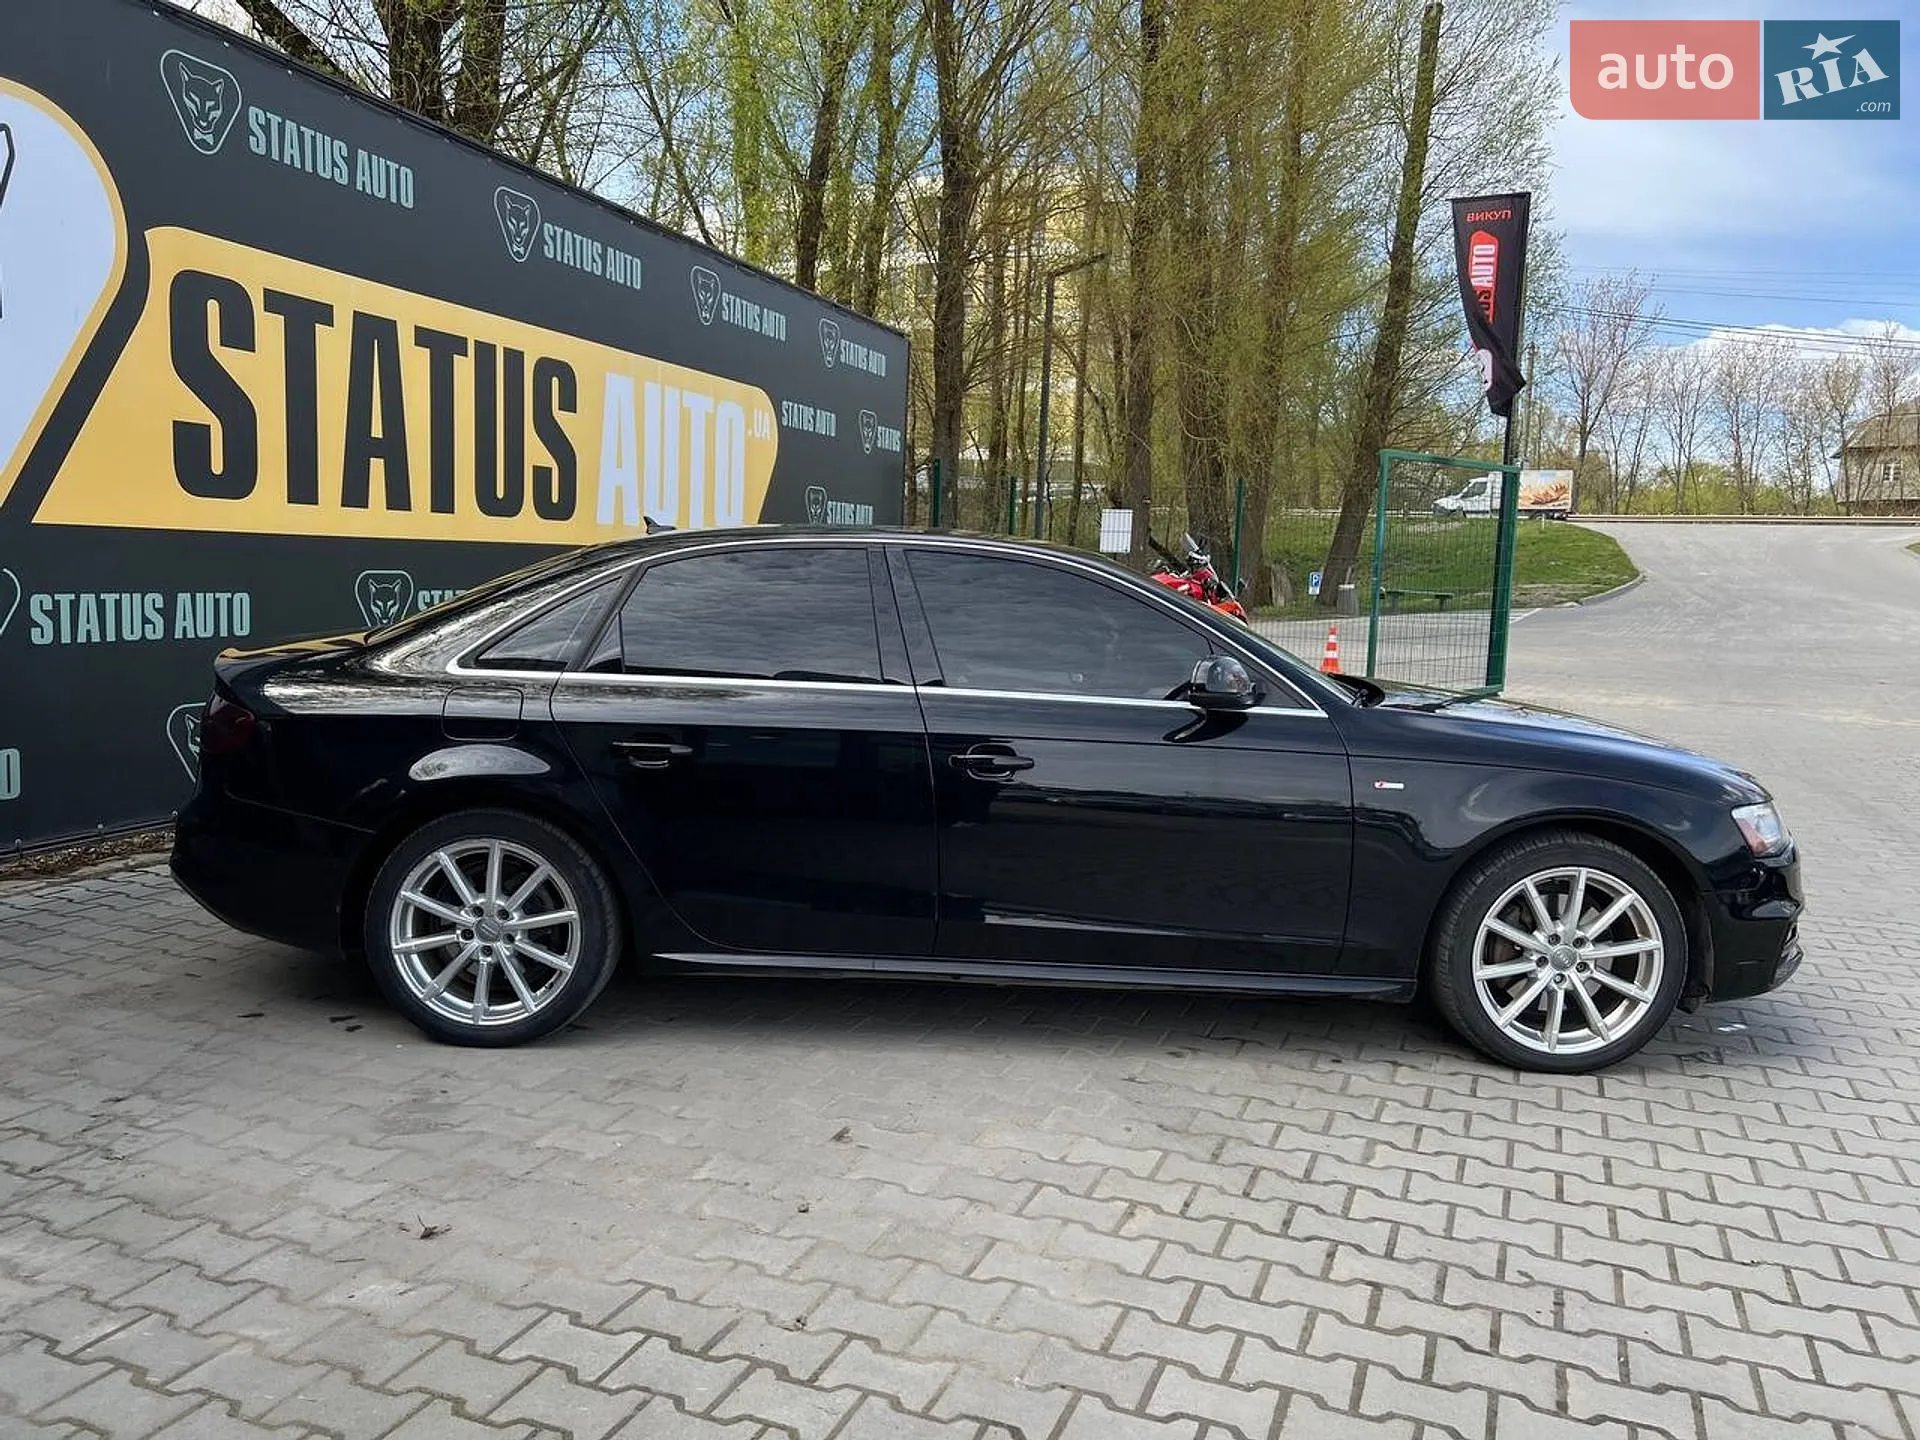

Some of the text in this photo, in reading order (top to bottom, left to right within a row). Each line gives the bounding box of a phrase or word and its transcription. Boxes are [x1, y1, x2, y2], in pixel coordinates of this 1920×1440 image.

[247, 105, 415, 210] STATUS AUTO
[1466, 209, 1512, 223] ВИКУП
[542, 222, 642, 291] STATUS AUTO
[1470, 243, 1496, 288] AUTO
[720, 291, 787, 343] STATUS AUTO
[839, 337, 887, 378] STATUS AUTO
[168, 267, 579, 522] STATUS
[781, 400, 837, 438] STATUS AUTO
[876, 425, 901, 453] STATUS
[826, 500, 873, 526] STATUS AUTO
[29, 591, 251, 646] STATUS AUTO
